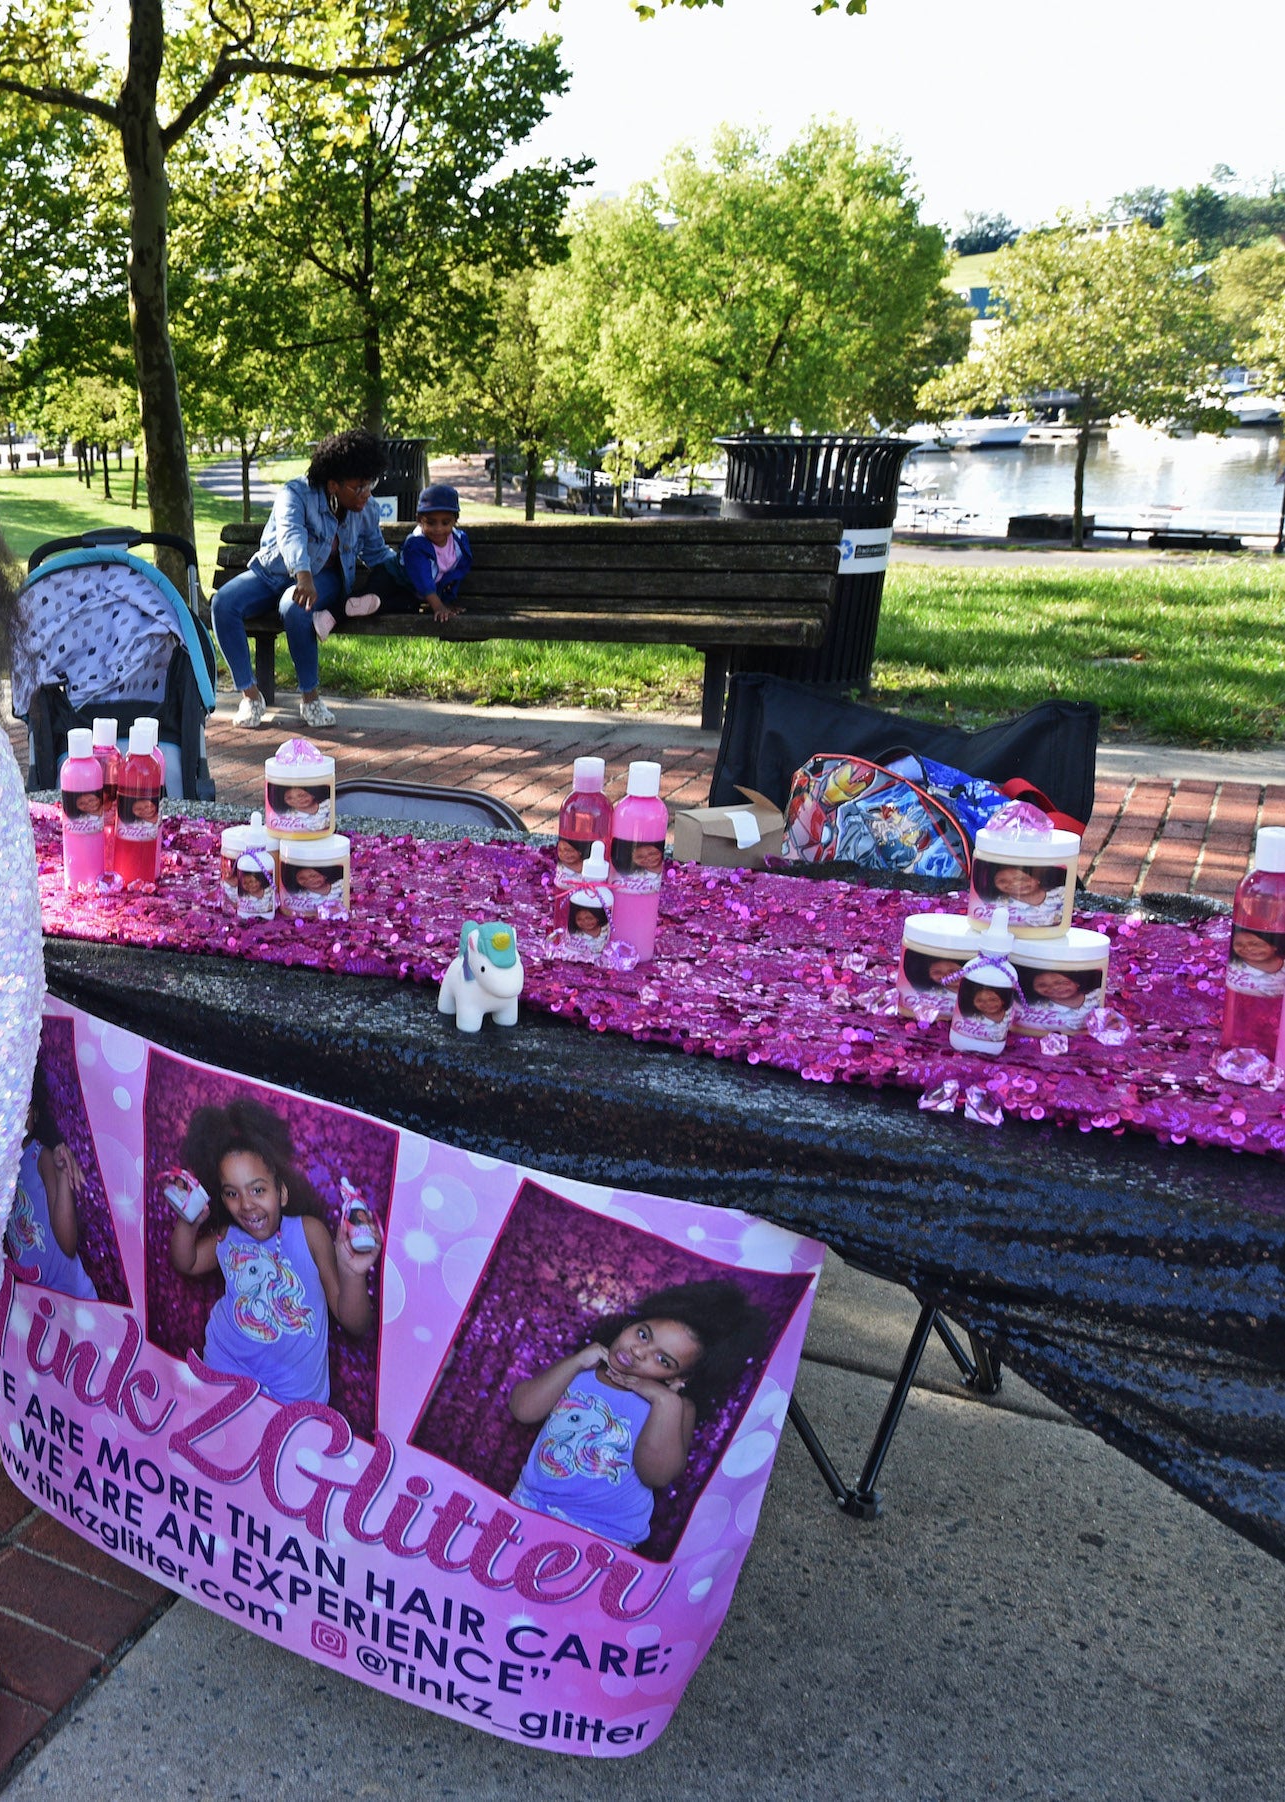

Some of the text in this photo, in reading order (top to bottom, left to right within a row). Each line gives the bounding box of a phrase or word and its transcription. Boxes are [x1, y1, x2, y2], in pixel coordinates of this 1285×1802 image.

[20, 1419, 63, 1479] WE
[73, 1466, 144, 1528] ARE
[155, 1511, 216, 1567] AN
[25, 1393, 84, 1457] ARE
[97, 1437, 213, 1524] MORE
[226, 1502, 346, 1588] THAN
[366, 1570, 485, 1644] HAIR
[505, 1625, 673, 1678] CARE;
[356, 1645, 650, 1745] @Tinkz_glitter
